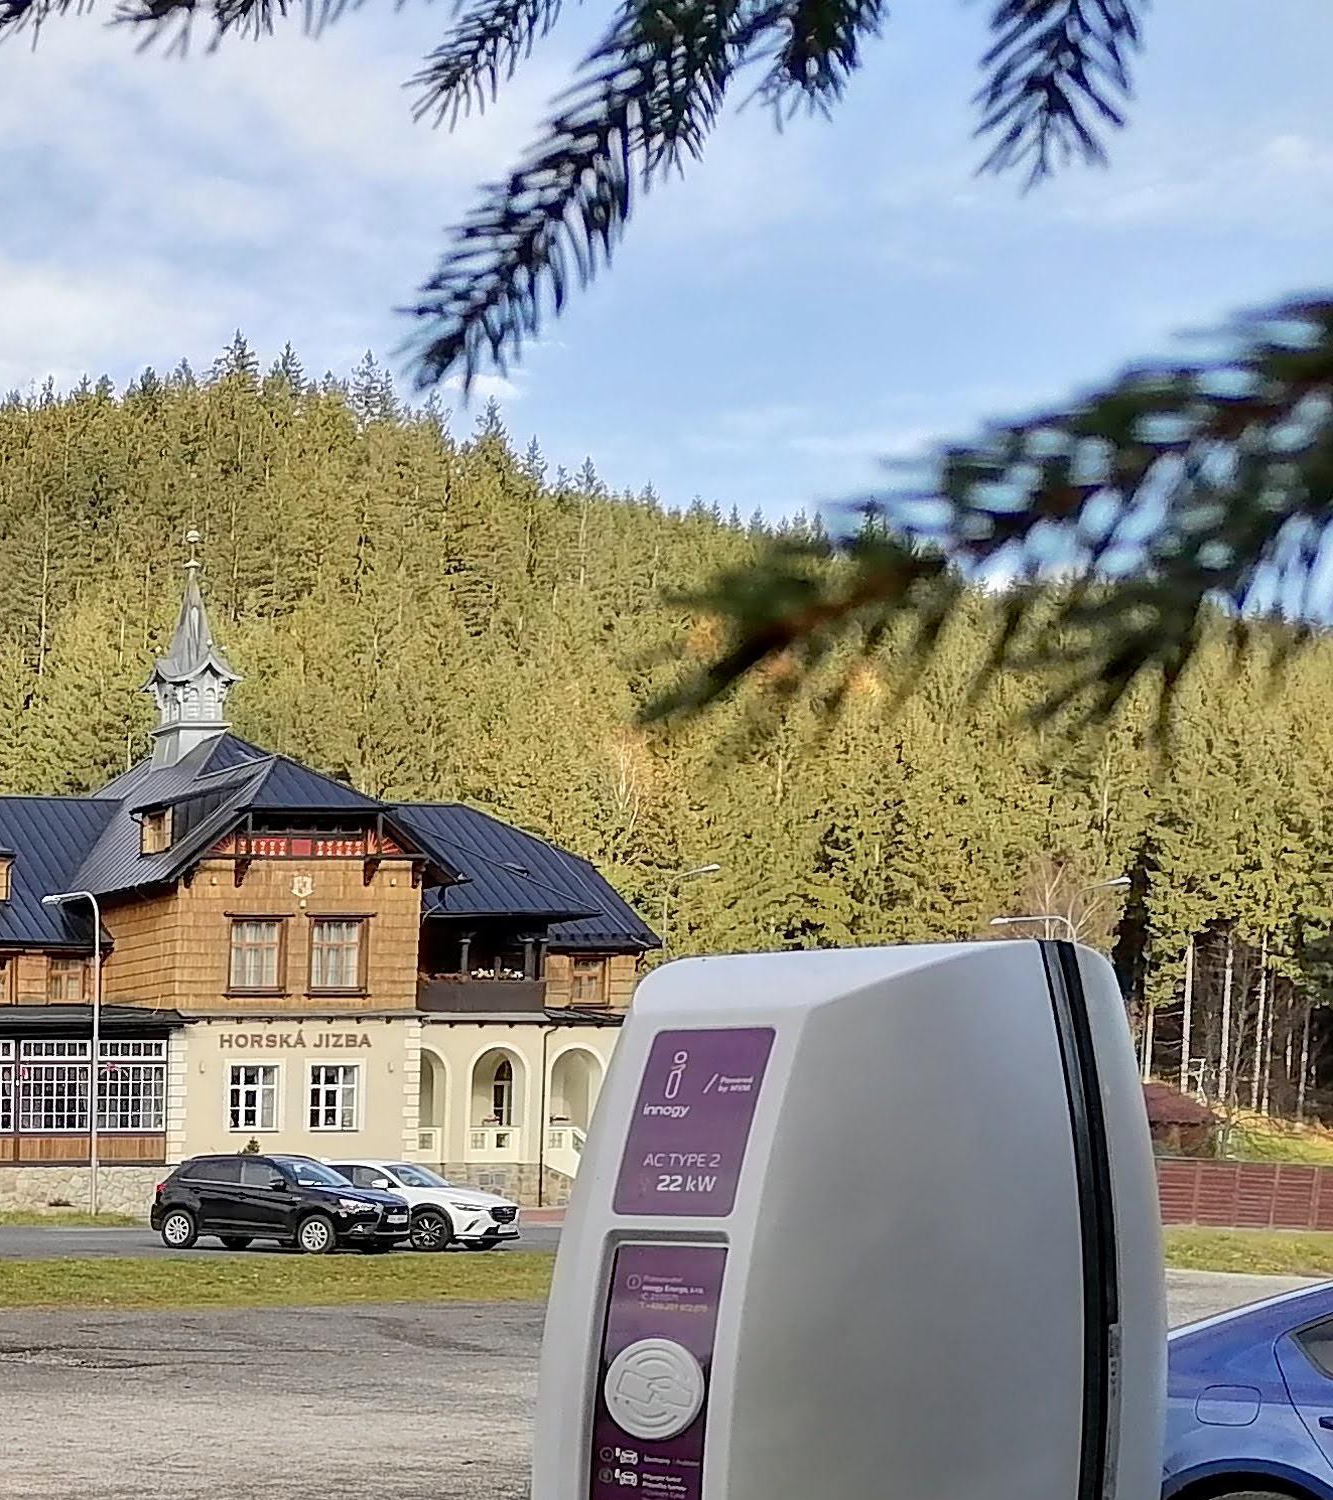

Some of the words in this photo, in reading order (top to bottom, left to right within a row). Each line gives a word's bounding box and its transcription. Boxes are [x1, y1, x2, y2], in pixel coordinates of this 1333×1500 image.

[219, 1028, 307, 1049] HORSKÁ
[313, 1033, 373, 1049] JIZBA
[643, 1102, 690, 1118] innogy
[643, 1153, 666, 1167] AC
[668, 1153, 706, 1167] TYPE
[708, 1153, 721, 1168] 2
[656, 1175, 682, 1192] 22
[685, 1175, 717, 1192] kW
